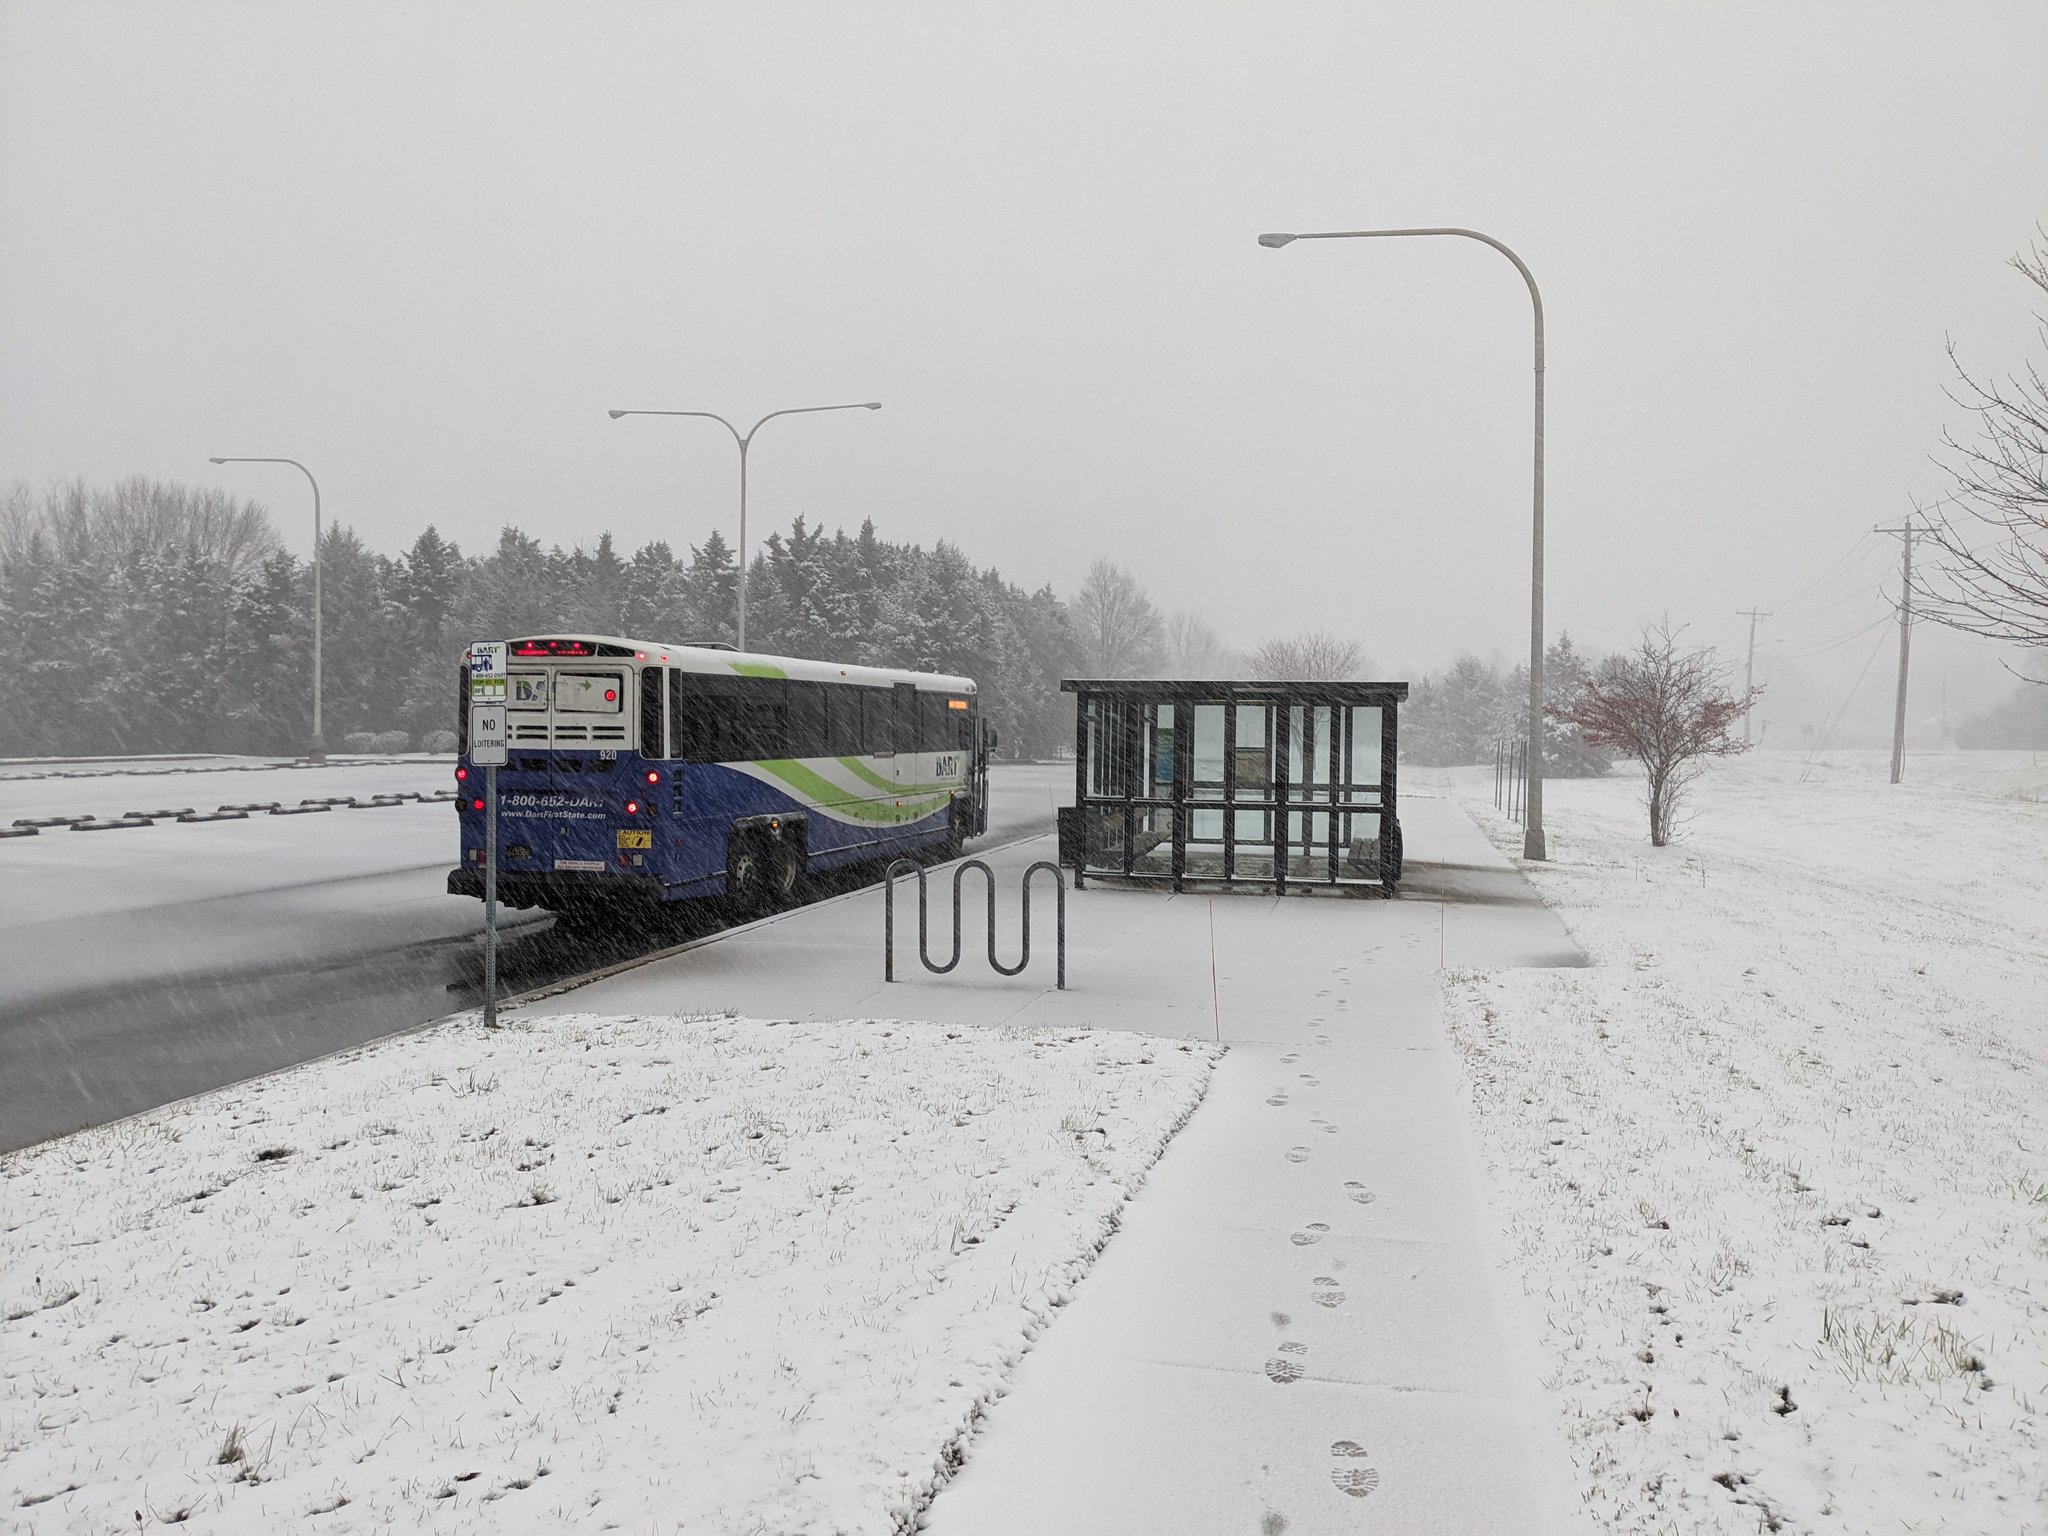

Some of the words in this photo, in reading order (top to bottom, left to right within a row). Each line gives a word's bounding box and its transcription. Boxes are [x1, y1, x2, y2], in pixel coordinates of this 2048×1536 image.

[482, 719, 496, 731] NO
[473, 739, 505, 748] LOITERING
[600, 750, 617, 760] 920
[935, 755, 960, 777] DART
[501, 810, 606, 820] www.DartFirstState.com
